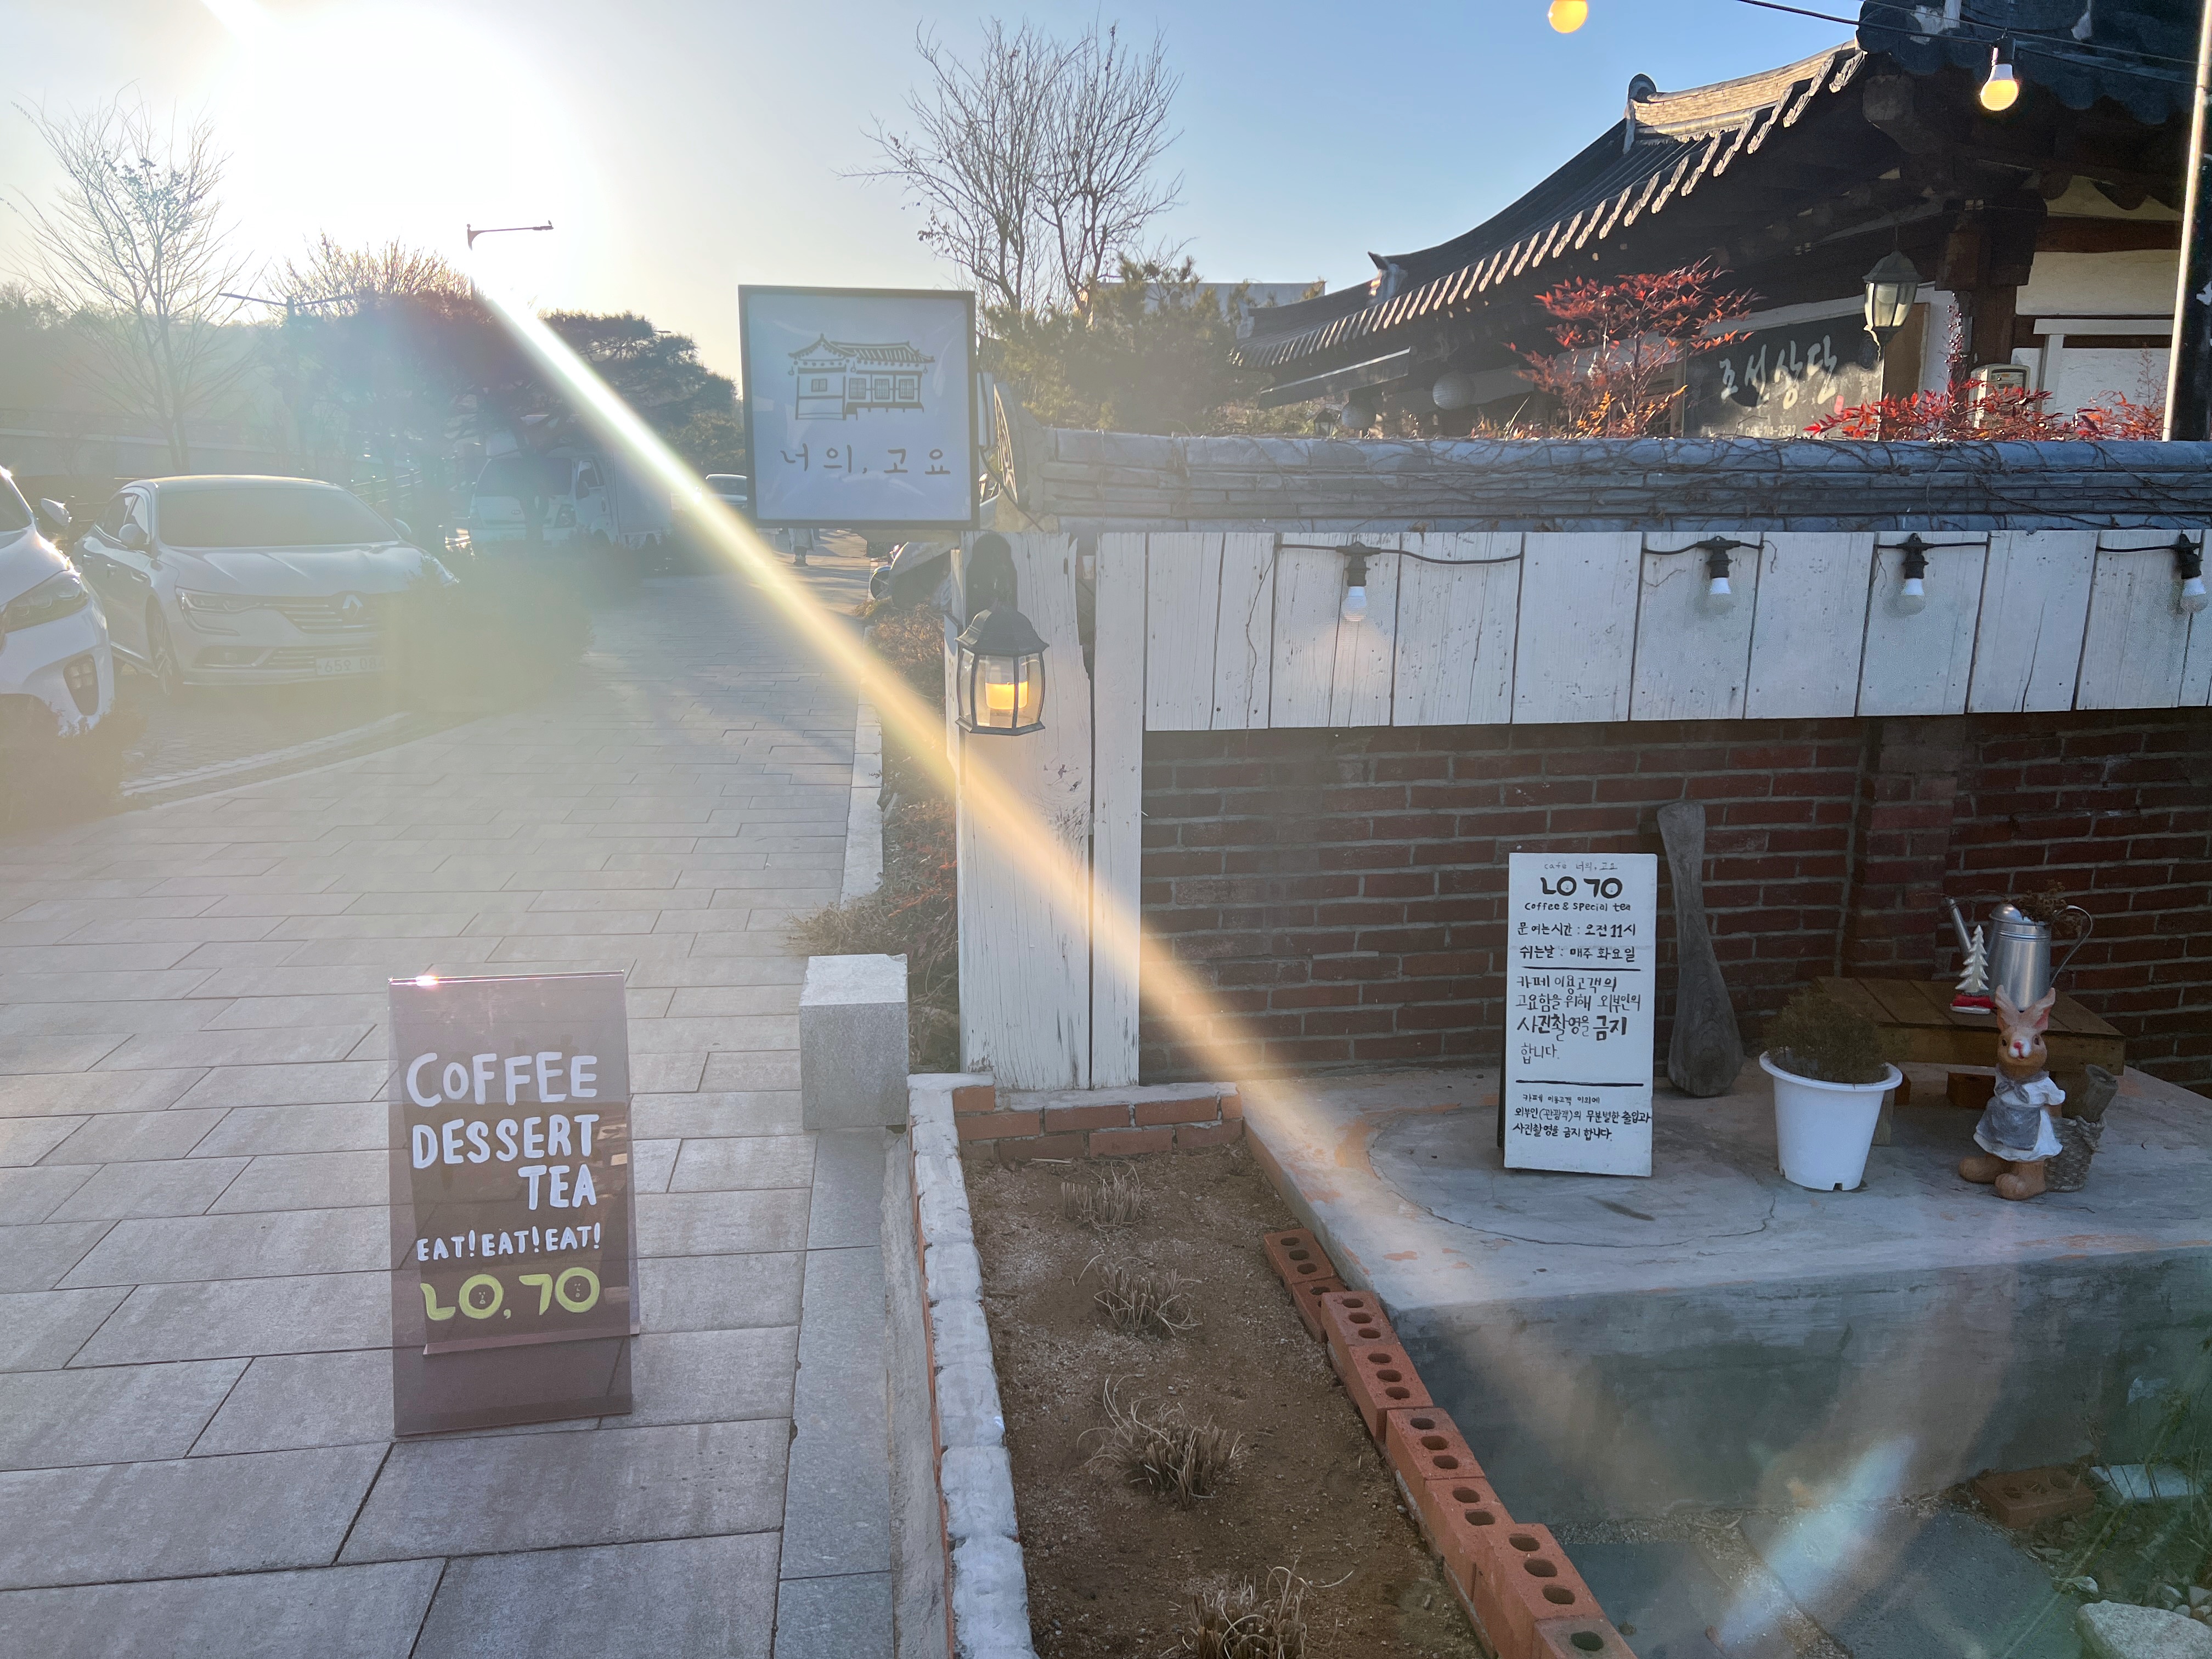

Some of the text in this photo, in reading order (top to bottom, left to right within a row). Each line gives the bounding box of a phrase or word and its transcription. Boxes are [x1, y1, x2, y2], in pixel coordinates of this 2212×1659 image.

[780, 442, 951, 475] 너의, 고요
[1576, 861, 1597, 872] 너의,
[1599, 862, 1618, 870] 고요
[1562, 902, 1569, 911] &
[1612, 903, 1631, 912] tea
[1585, 924, 1607, 937] 오전
[1519, 945, 1555, 959] 쉬는날
[1570, 947, 1593, 960] 매주
[1596, 946, 1635, 963] 화요일
[1516, 975, 1550, 988] 카페
[1597, 994, 1641, 1013] 외부인의
[1517, 1013, 1627, 1041] 사진촬영을 금지
[406, 1052, 597, 1107] COFFEE
[1523, 1094, 1543, 1102] 카페
[1548, 1096, 1572, 1105] 이용고객
[1513, 1122, 1559, 1137] 사진촬영을
[413, 1114, 599, 1169] DESSERT
[518, 1164, 597, 1210] TEA
